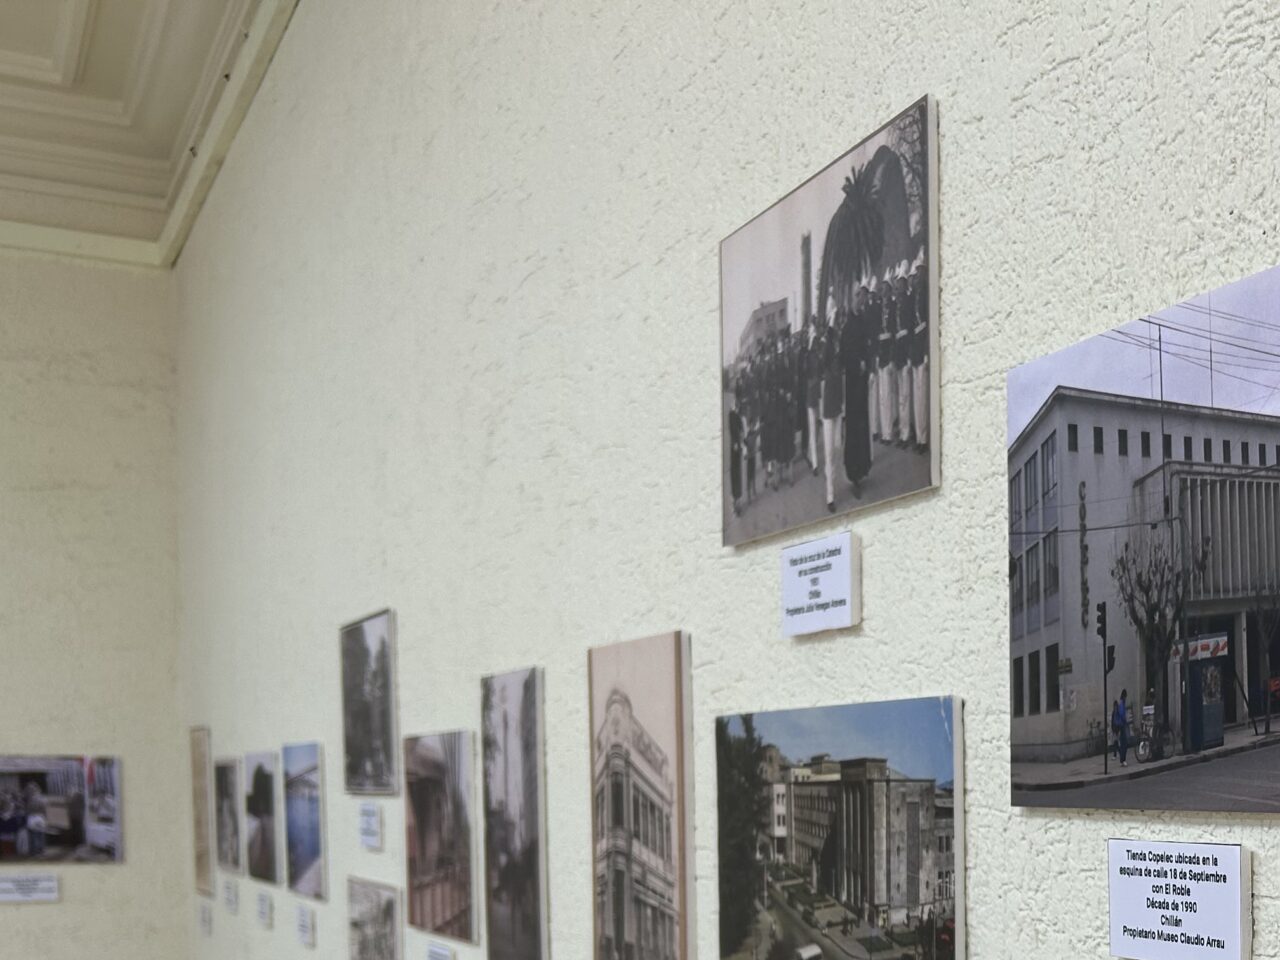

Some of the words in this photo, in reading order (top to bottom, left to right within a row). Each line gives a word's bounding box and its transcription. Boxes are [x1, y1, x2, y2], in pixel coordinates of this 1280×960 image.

[1126, 849, 1147, 861] Tienda
[1148, 851, 1173, 864] Copelec
[1174, 853, 1201, 866] ubicada
[1202, 856, 1210, 866] en
[1211, 854, 1218, 866] la
[1119, 865, 1143, 878] esquina
[1144, 866, 1152, 878] de
[1153, 867, 1168, 879] calle
[1169, 868, 1178, 880] 18
[1179, 869, 1187, 880] de
[1188, 870, 1227, 883] Septiembre
[1152, 884, 1163, 894] con
[1165, 883, 1171, 894] El
[1172, 884, 1191, 896] Roble
[1146, 897, 1170, 910] Década
[1171, 899, 1179, 911] de
[1180, 901, 1197, 913] 1990
[1160, 914, 1182, 928] Chillán
[1122, 925, 1155, 940] Propietario
[1157, 929, 1179, 943] Museo
[1180, 932, 1204, 946] Claudio
[1206, 936, 1225, 949] Arrau
